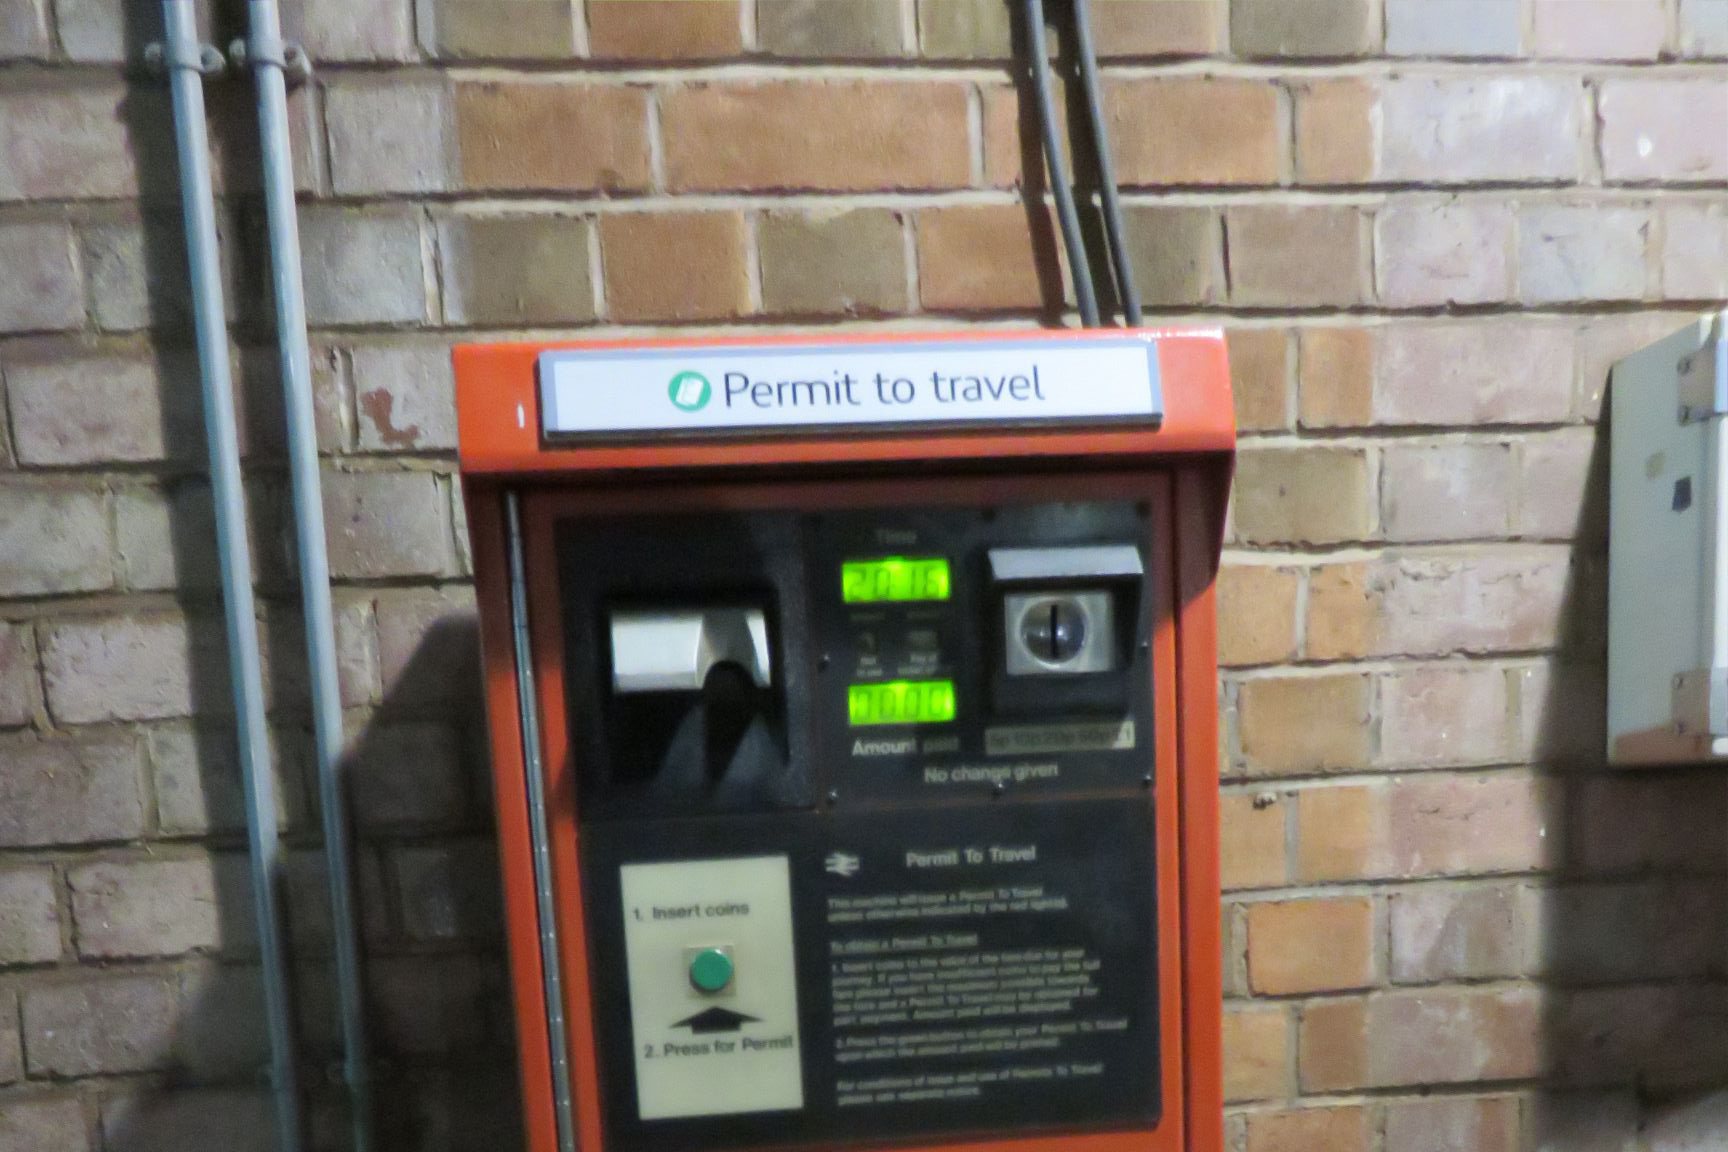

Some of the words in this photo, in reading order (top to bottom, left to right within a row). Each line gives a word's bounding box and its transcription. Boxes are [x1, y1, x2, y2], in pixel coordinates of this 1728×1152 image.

[723, 369, 860, 408] Permit
[872, 371, 915, 406] to
[929, 364, 1045, 403] travel
[852, 737, 917, 756] Amount
[924, 767, 948, 782] No
[950, 765, 1011, 786] change
[1014, 762, 1059, 782] given
[906, 850, 959, 868] Permit
[964, 848, 984, 863] To
[989, 844, 1037, 863] Travel
[652, 904, 700, 920] Insert
[705, 902, 750, 917] coins
[664, 1043, 711, 1057] Press
[714, 1040, 736, 1053] for
[742, 1035, 794, 1051] Permit
